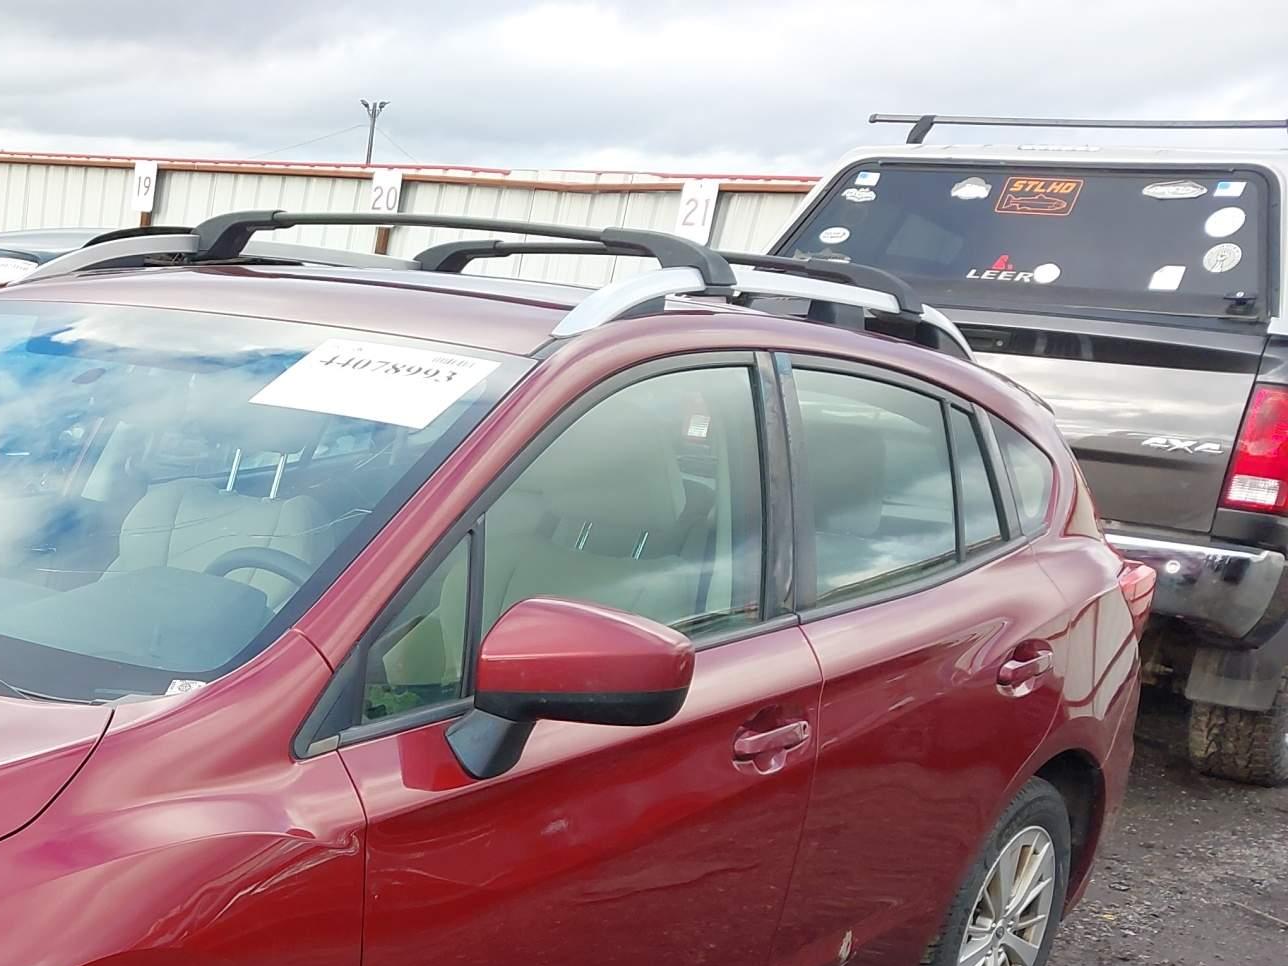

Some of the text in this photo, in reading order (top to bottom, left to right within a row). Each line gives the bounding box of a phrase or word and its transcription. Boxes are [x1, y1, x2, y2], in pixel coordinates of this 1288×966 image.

[137, 175, 151, 197] 19
[371, 185, 398, 211] 20
[1009, 180, 1077, 193] STLHD
[681, 198, 711, 227] 21
[965, 268, 1034, 283] LEER
[319, 353, 457, 382] 44078993
